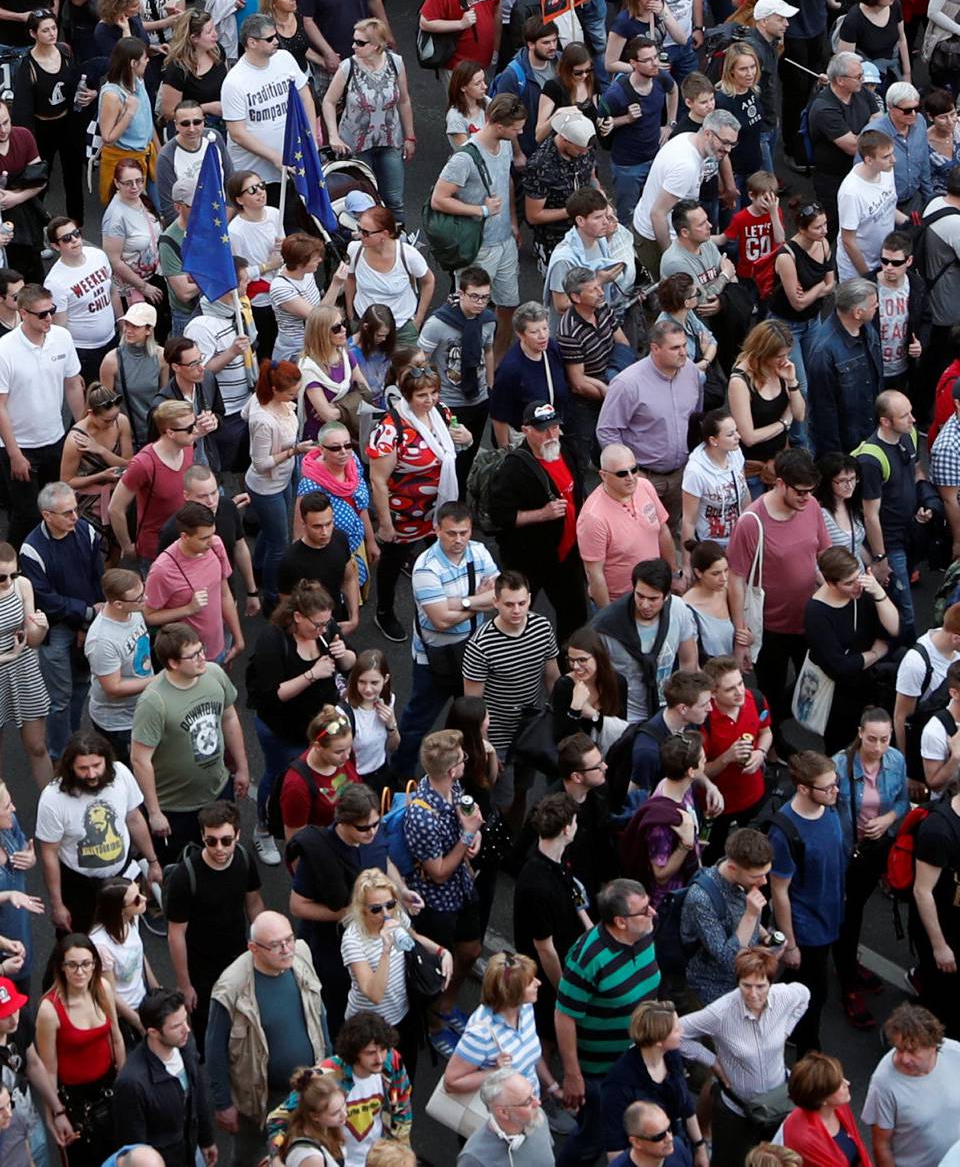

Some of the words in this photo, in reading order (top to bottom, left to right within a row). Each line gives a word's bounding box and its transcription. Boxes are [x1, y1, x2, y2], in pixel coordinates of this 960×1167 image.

[248, 103, 288, 122] Compan
[745, 235, 772, 262] GO
[87, 294, 111, 314] CHIL
